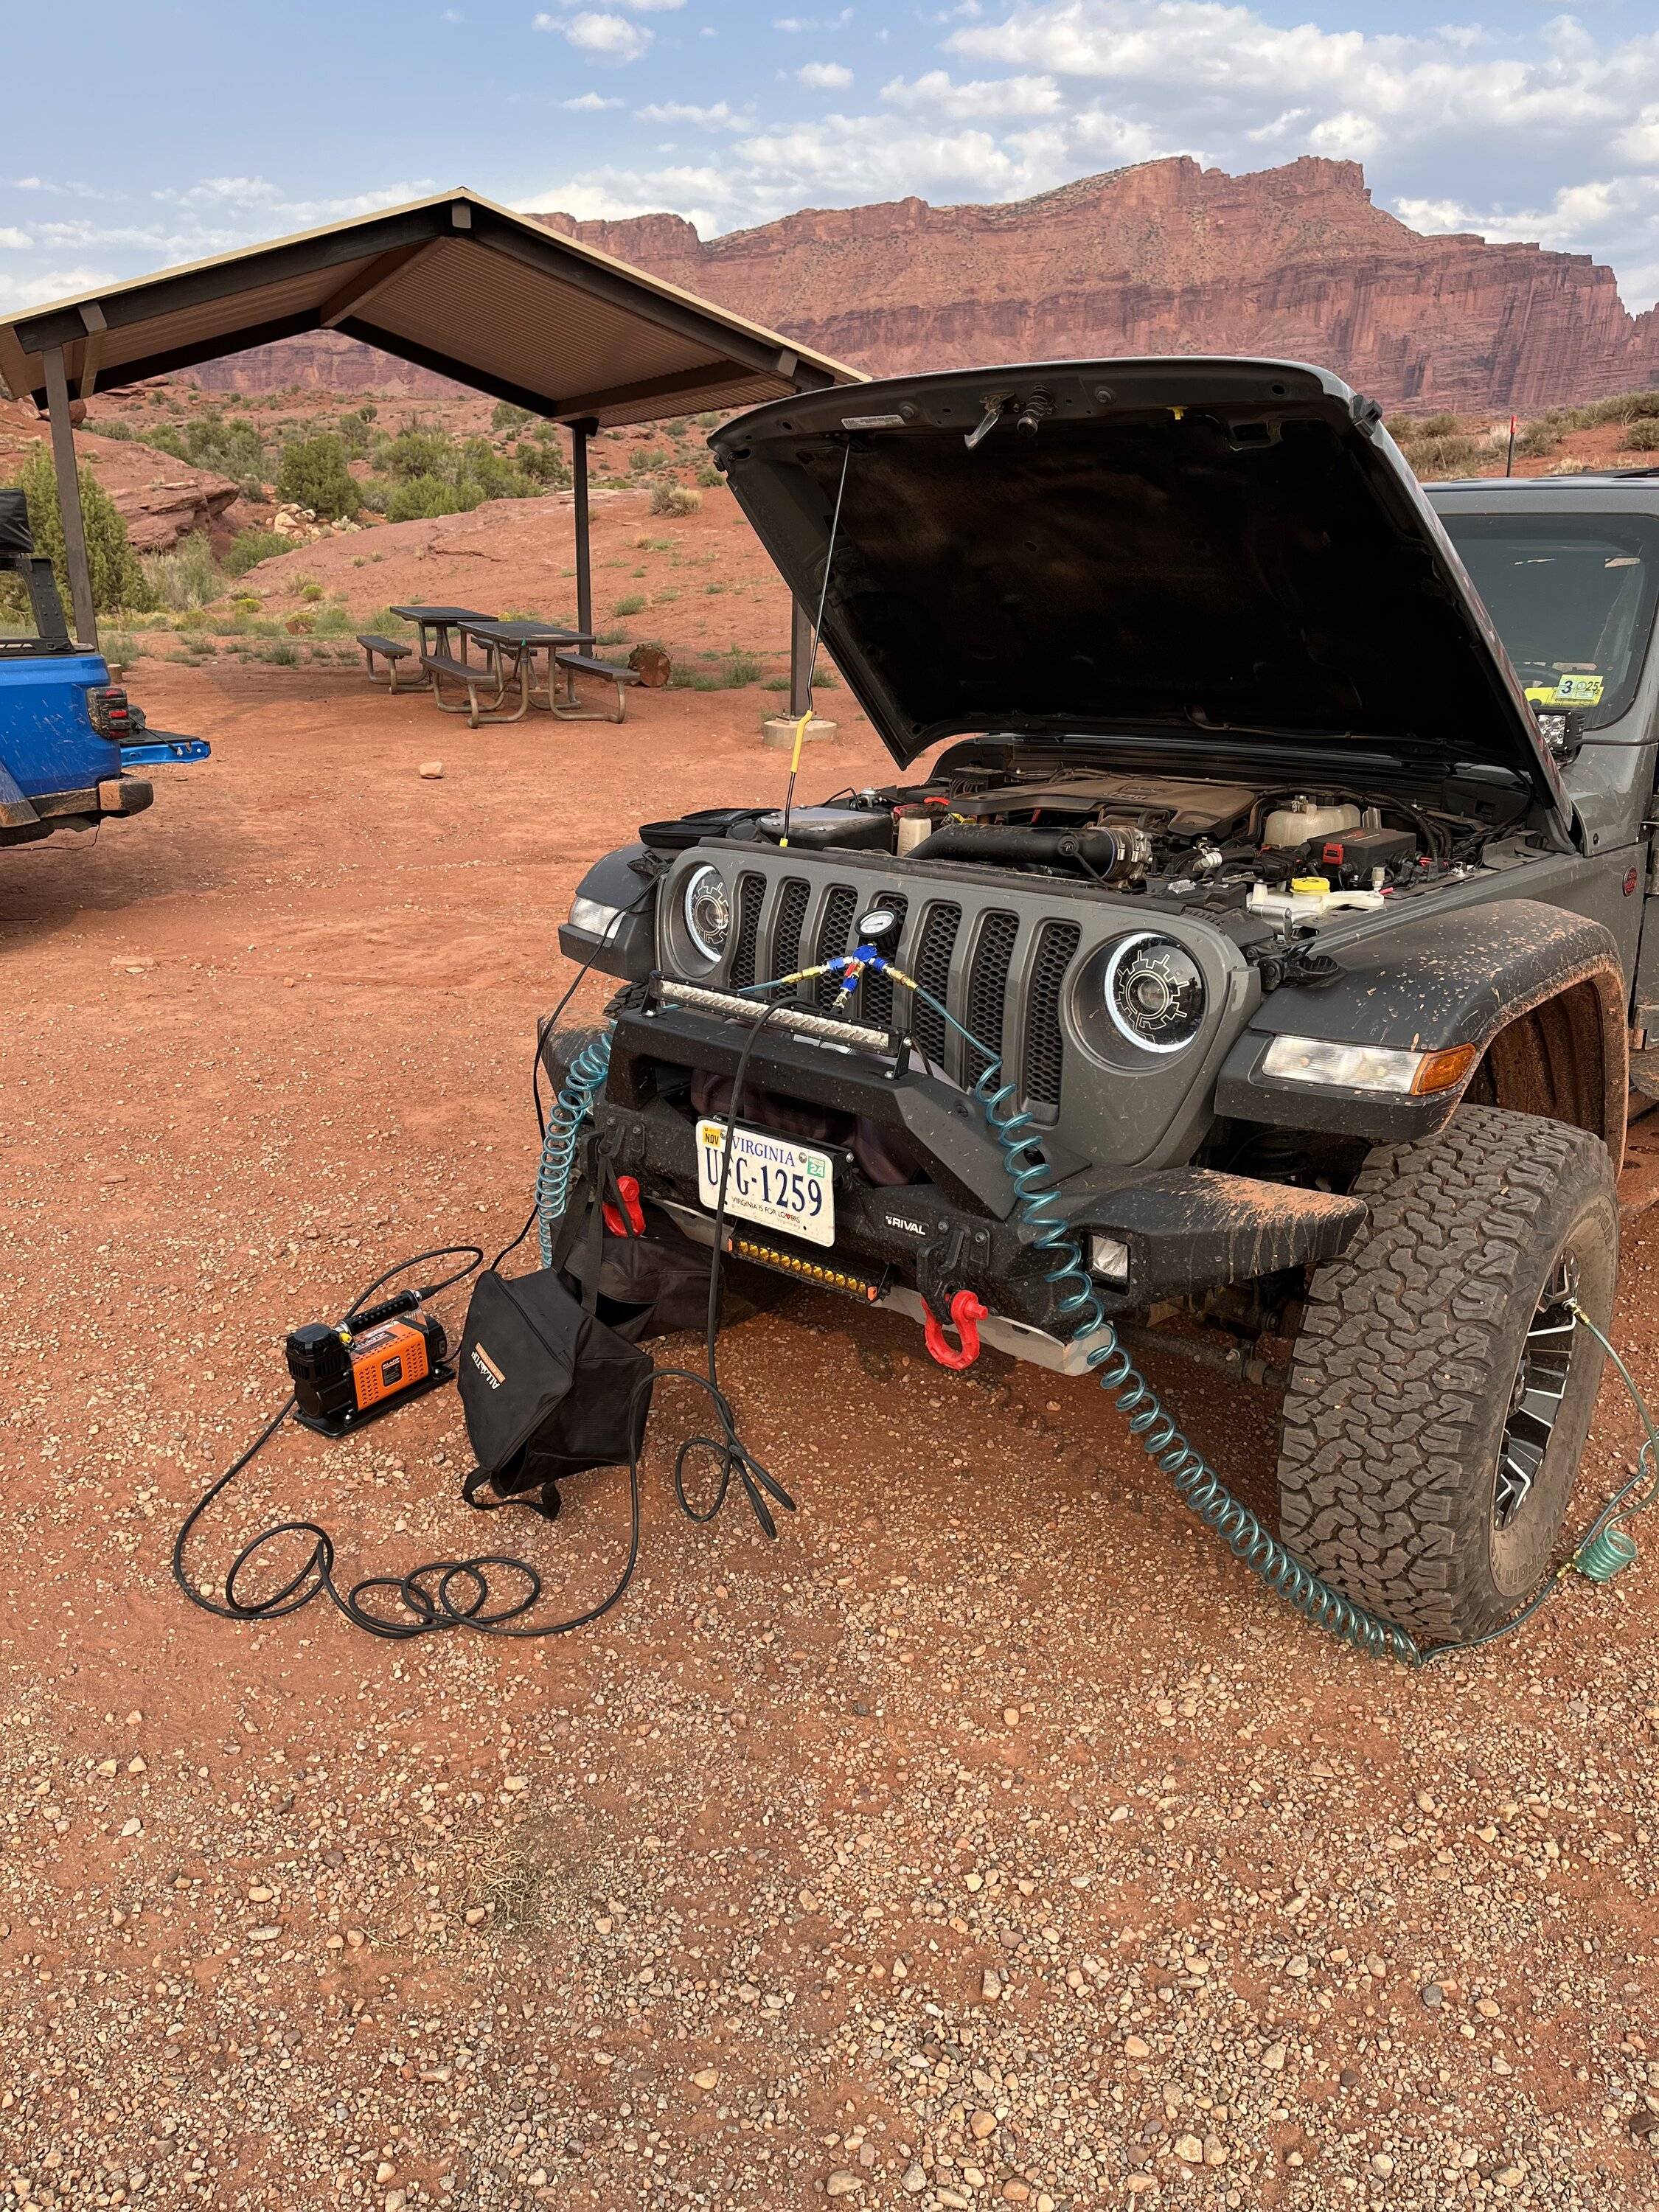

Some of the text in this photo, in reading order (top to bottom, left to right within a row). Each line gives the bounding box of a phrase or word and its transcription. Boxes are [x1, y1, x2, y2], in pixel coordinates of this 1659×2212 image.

[1561, 680, 1599, 694] 3 25
[705, 1133, 719, 1144] NOV
[731, 1135, 796, 1167] VIRGINIA
[731, 1197, 757, 1210] VIRGINIA
[765, 1206, 776, 1216] FOR
[892, 1217, 926, 1235] RIVAL
